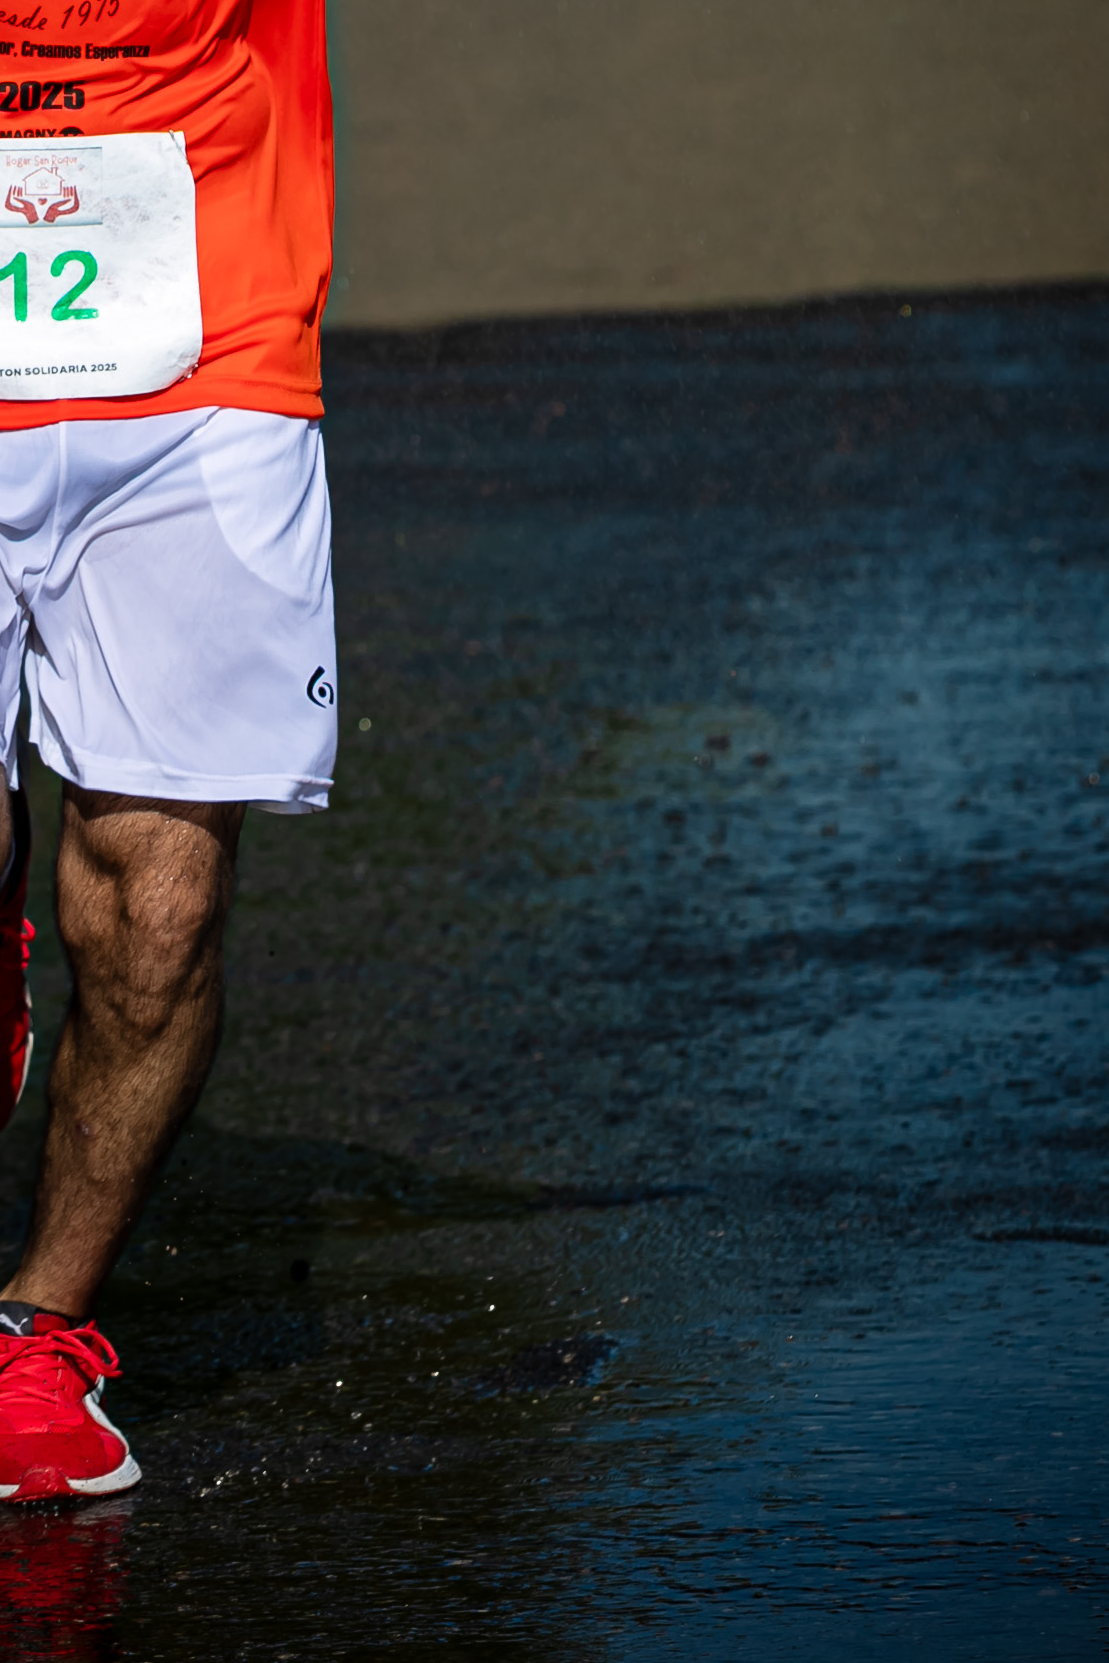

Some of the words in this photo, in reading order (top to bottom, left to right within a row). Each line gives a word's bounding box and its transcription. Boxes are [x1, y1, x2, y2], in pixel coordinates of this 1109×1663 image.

[21, 40, 82, 59] Creamos
[85, 43, 151, 62] Esperanza
[5, 155, 31, 169] Hogar
[34, 154, 50, 167] San
[51, 154, 78, 168] Roque
[24, 364, 88, 376] SOLIDARIA
[90, 362, 118, 373] 2025
